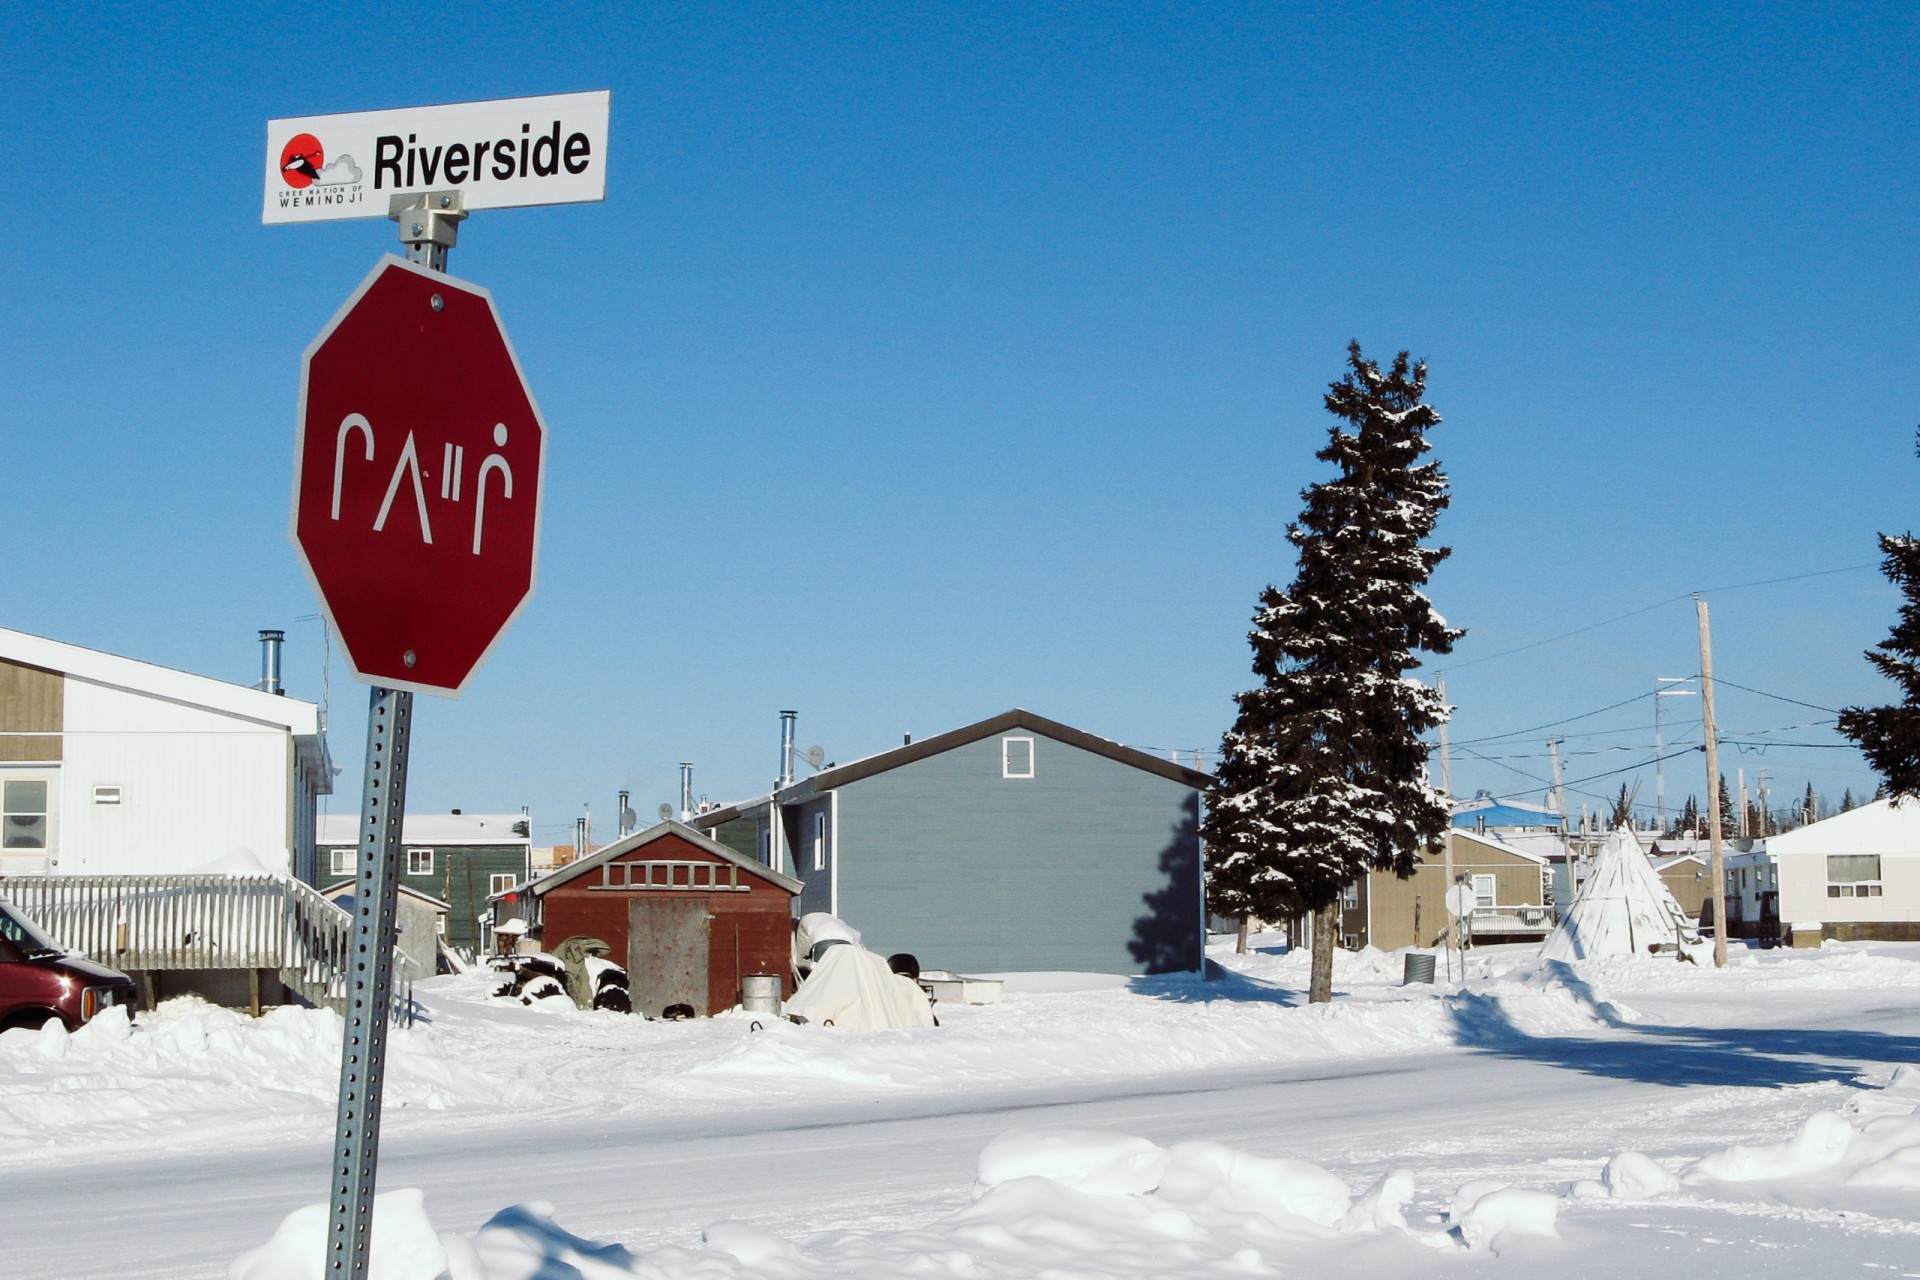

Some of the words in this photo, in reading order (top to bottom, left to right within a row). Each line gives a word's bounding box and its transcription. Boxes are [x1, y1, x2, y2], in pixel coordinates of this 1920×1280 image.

[374, 120, 591, 189] Riverside
[309, 187, 345, 195] NATION
[280, 192, 363, 208] WEMINDJI
